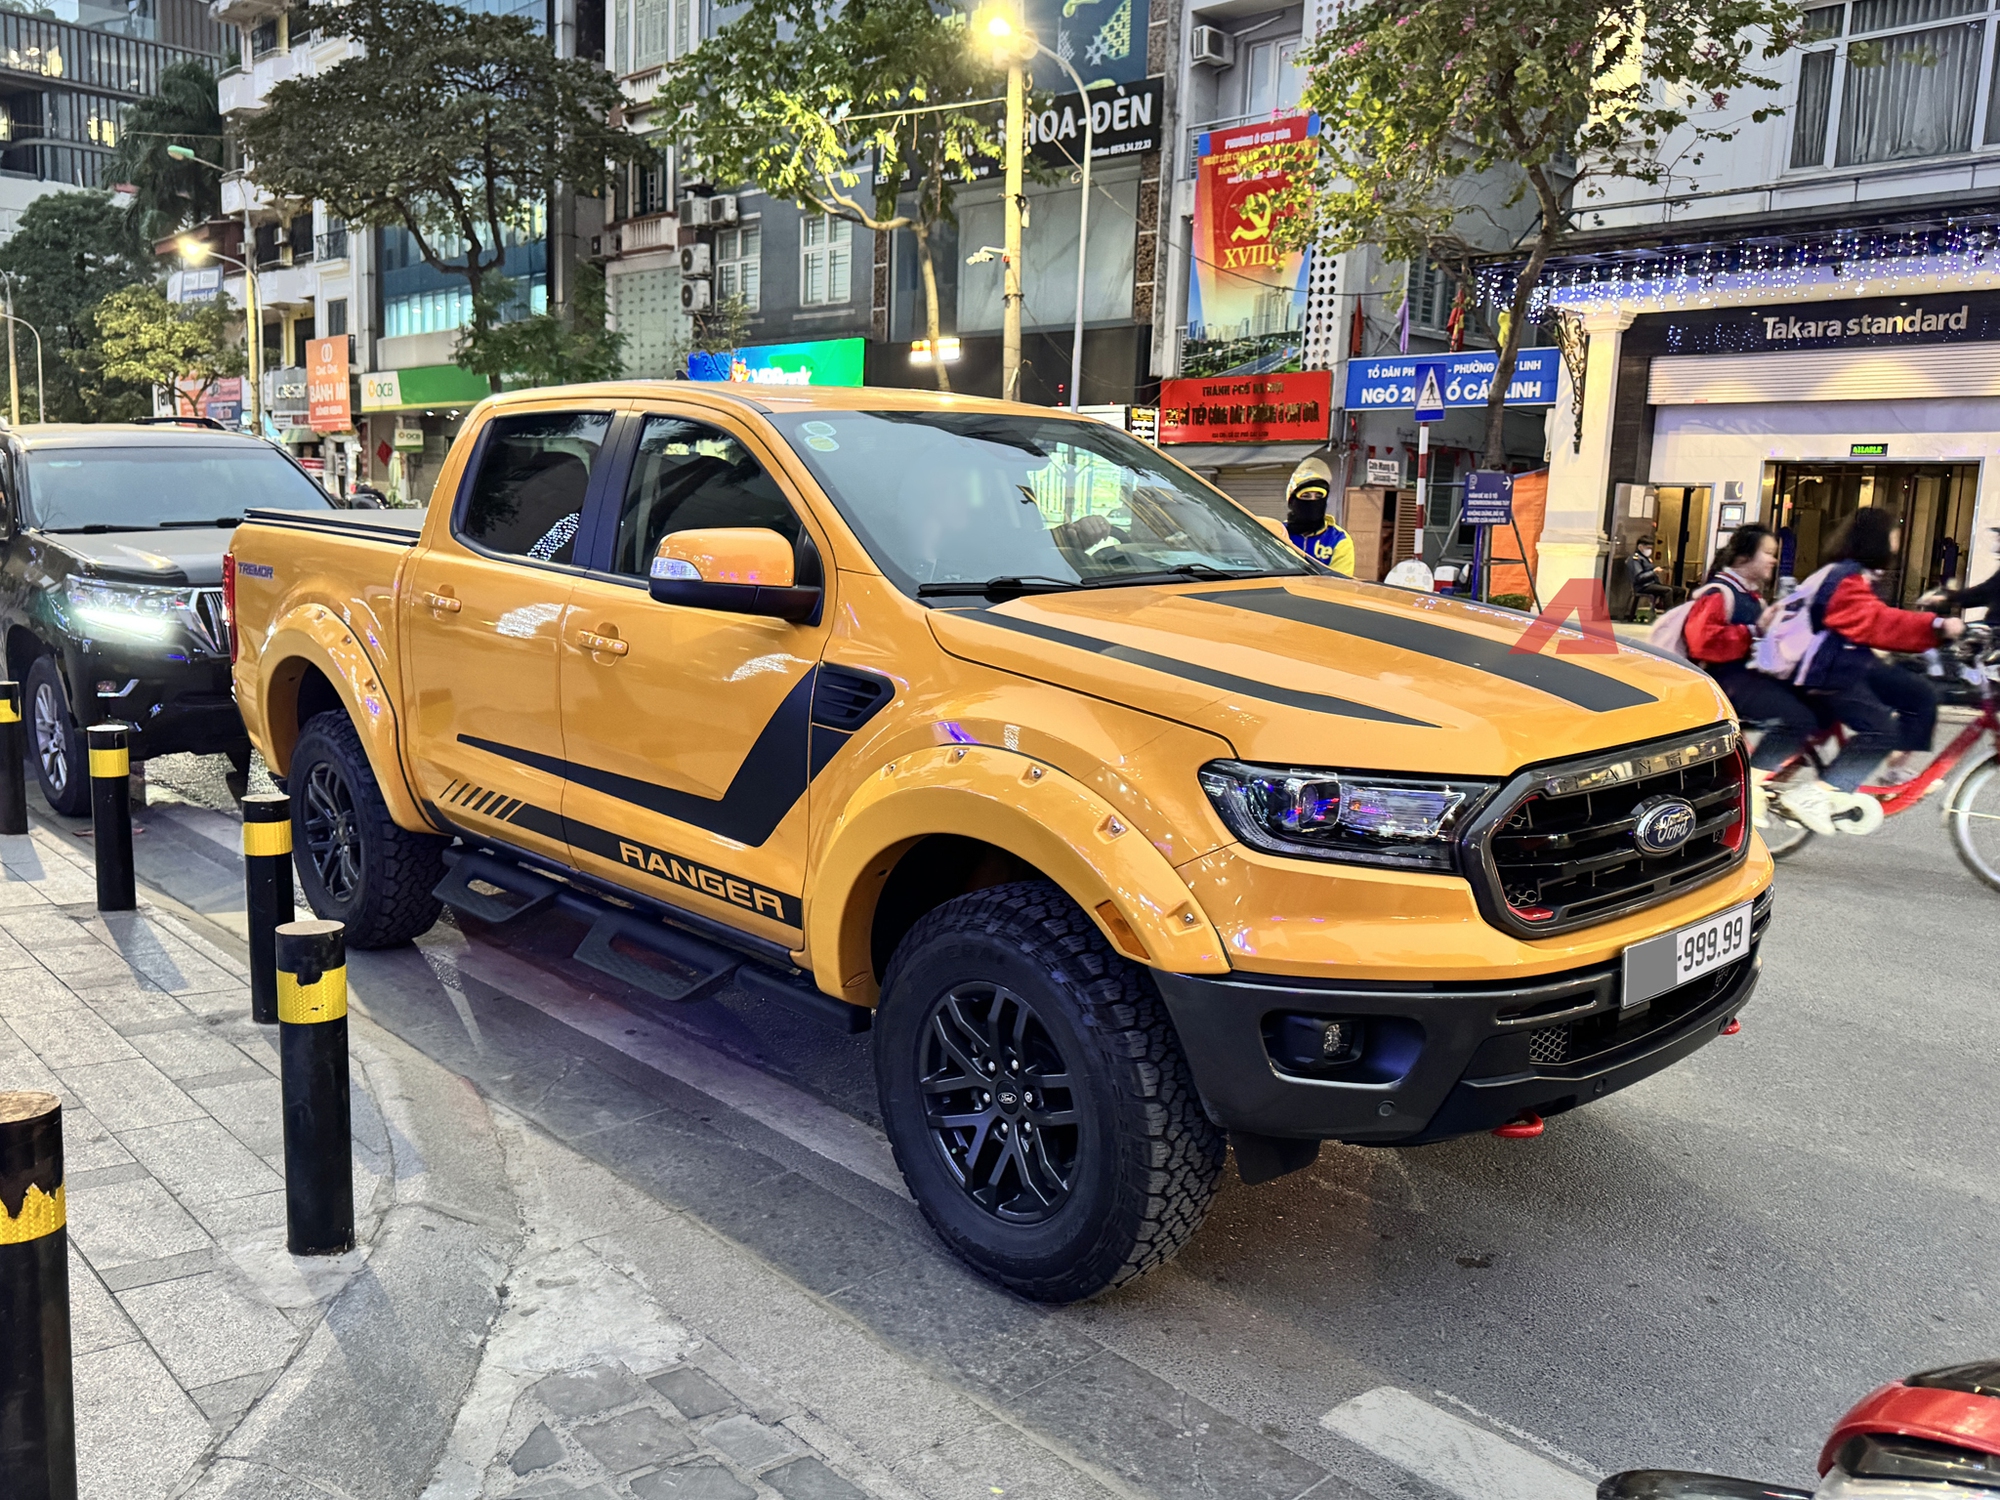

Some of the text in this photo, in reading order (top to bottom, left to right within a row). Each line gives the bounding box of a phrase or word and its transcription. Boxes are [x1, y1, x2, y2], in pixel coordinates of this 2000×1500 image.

[1763, 305, 1969, 340] Takara standard
[1367, 363, 1380, 379] TỔ
[1381, 365, 1401, 378] DÂN
[1453, 359, 1495, 374] PHƯỜNG
[1518, 359, 1542, 371] LINH
[309, 380, 334, 403] BÁNH
[376, 382, 394, 398] OCB
[1361, 383, 1399, 404] NGÕ
[1463, 378, 1493, 400] CÁ
[1313, 540, 1333, 559] be
[237, 561, 275, 580] TREMOR
[1653, 811, 1691, 844] Ford
[618, 841, 785, 919] RANGER
